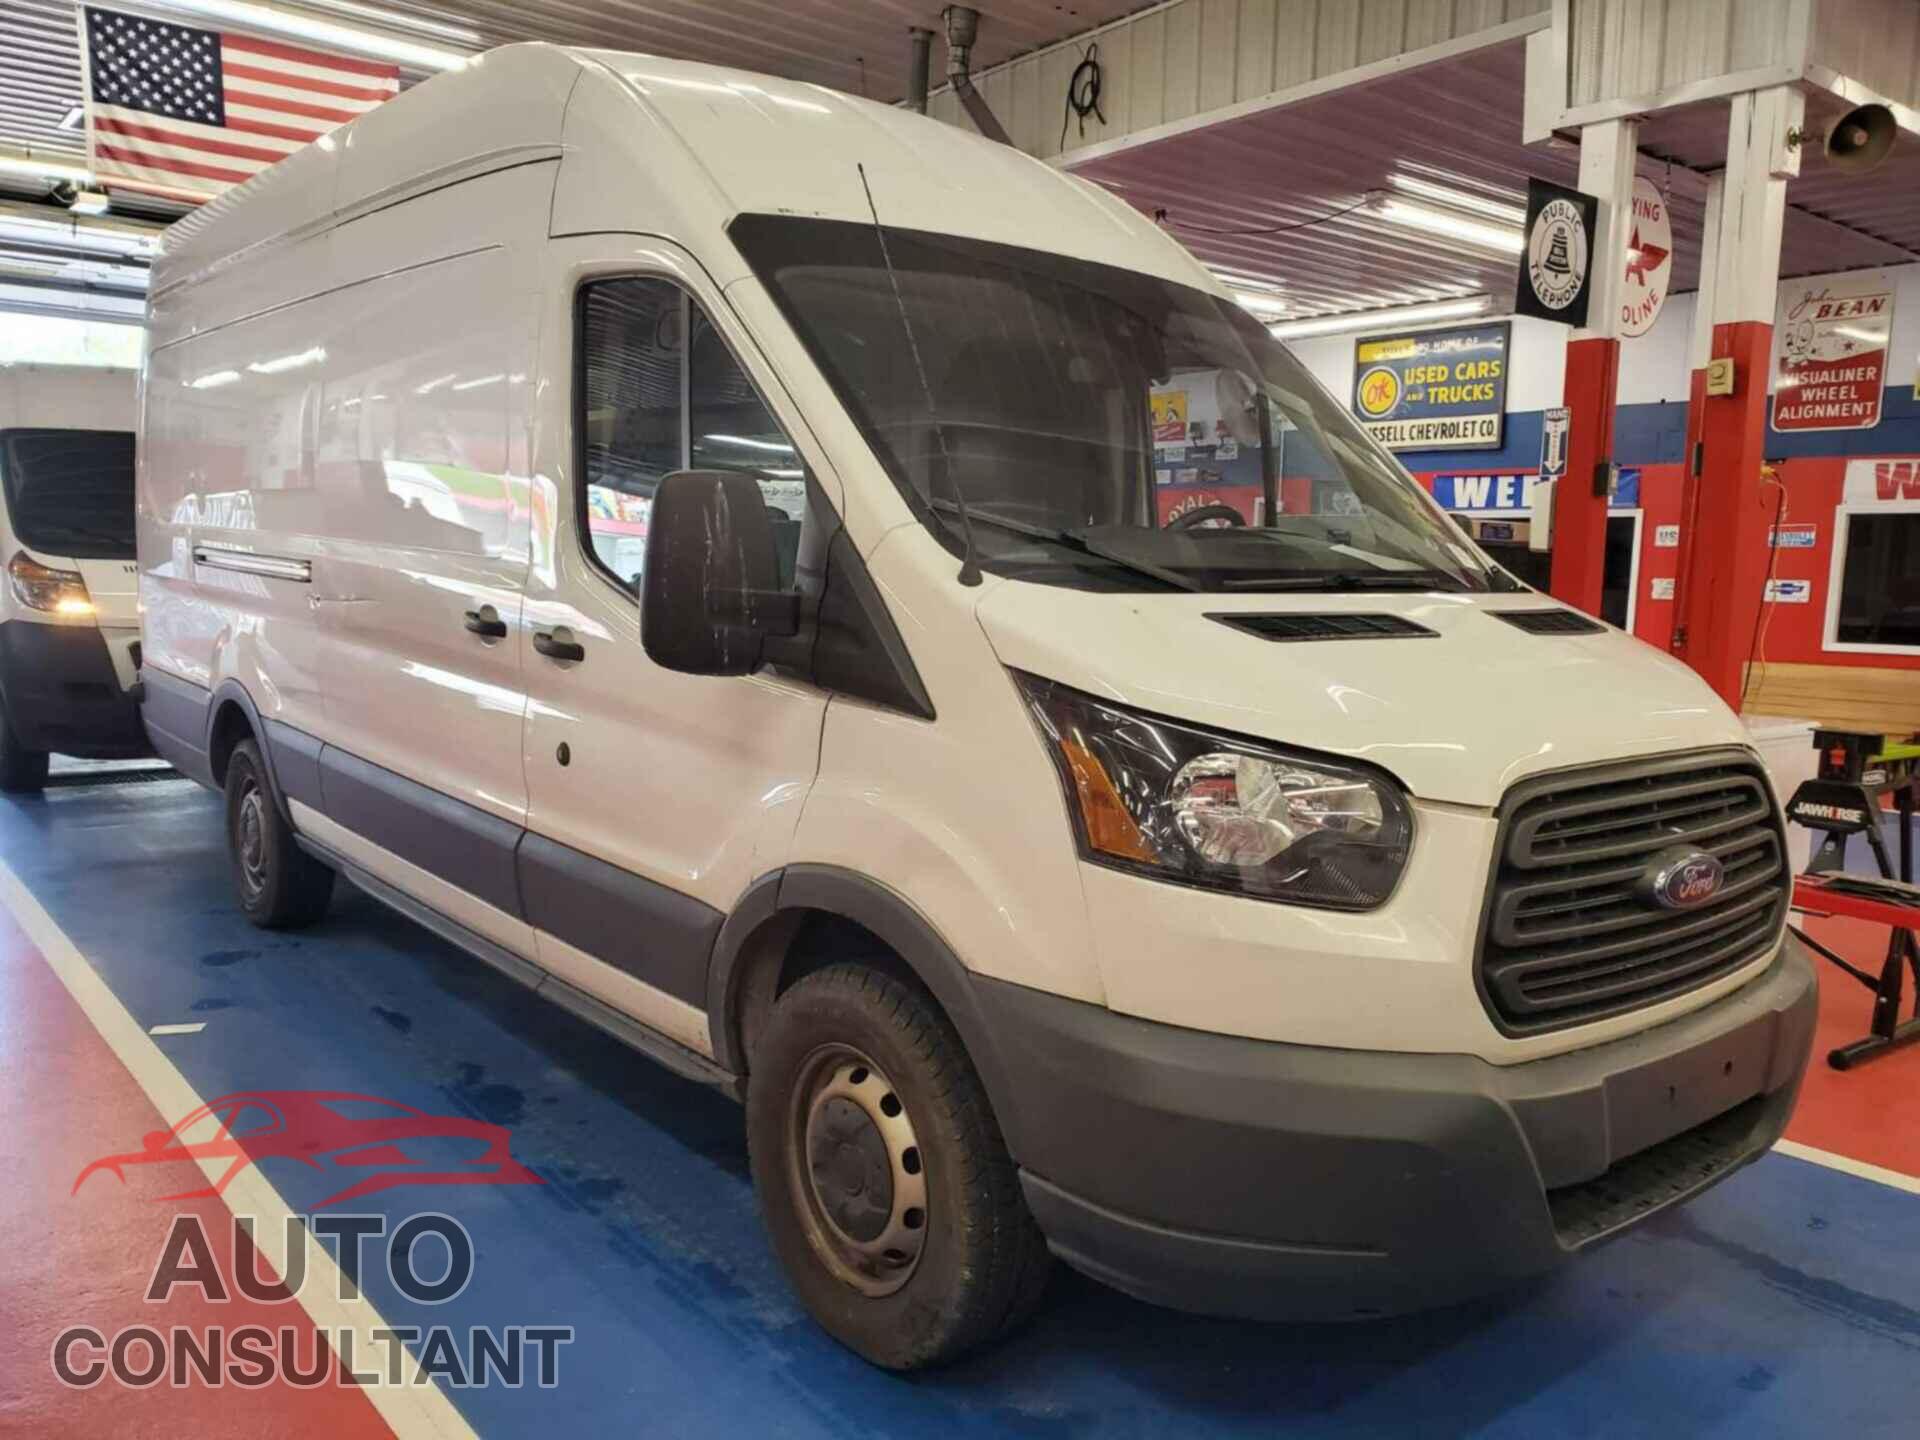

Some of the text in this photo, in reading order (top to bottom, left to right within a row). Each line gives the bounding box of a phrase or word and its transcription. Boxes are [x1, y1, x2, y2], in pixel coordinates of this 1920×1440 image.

[1542, 204, 1582, 233] PUBLIC
[1632, 197, 1660, 222] YING
[1531, 260, 1582, 306] TELEPHONE
[1621, 288, 1658, 326] OLINE
[1816, 298, 1886, 319] BEAN
[1404, 360, 1501, 385] USED CARS
[1406, 384, 1495, 404] AND TRUCKS
[1801, 386, 1859, 402] WHEEL
[1778, 402, 1875, 420] ALIGNMENT
[1368, 419, 1496, 442] SSELL CHEVROLET CO.
[1165, 494, 1206, 525] OYAL
[1680, 865, 1715, 898] Ford
